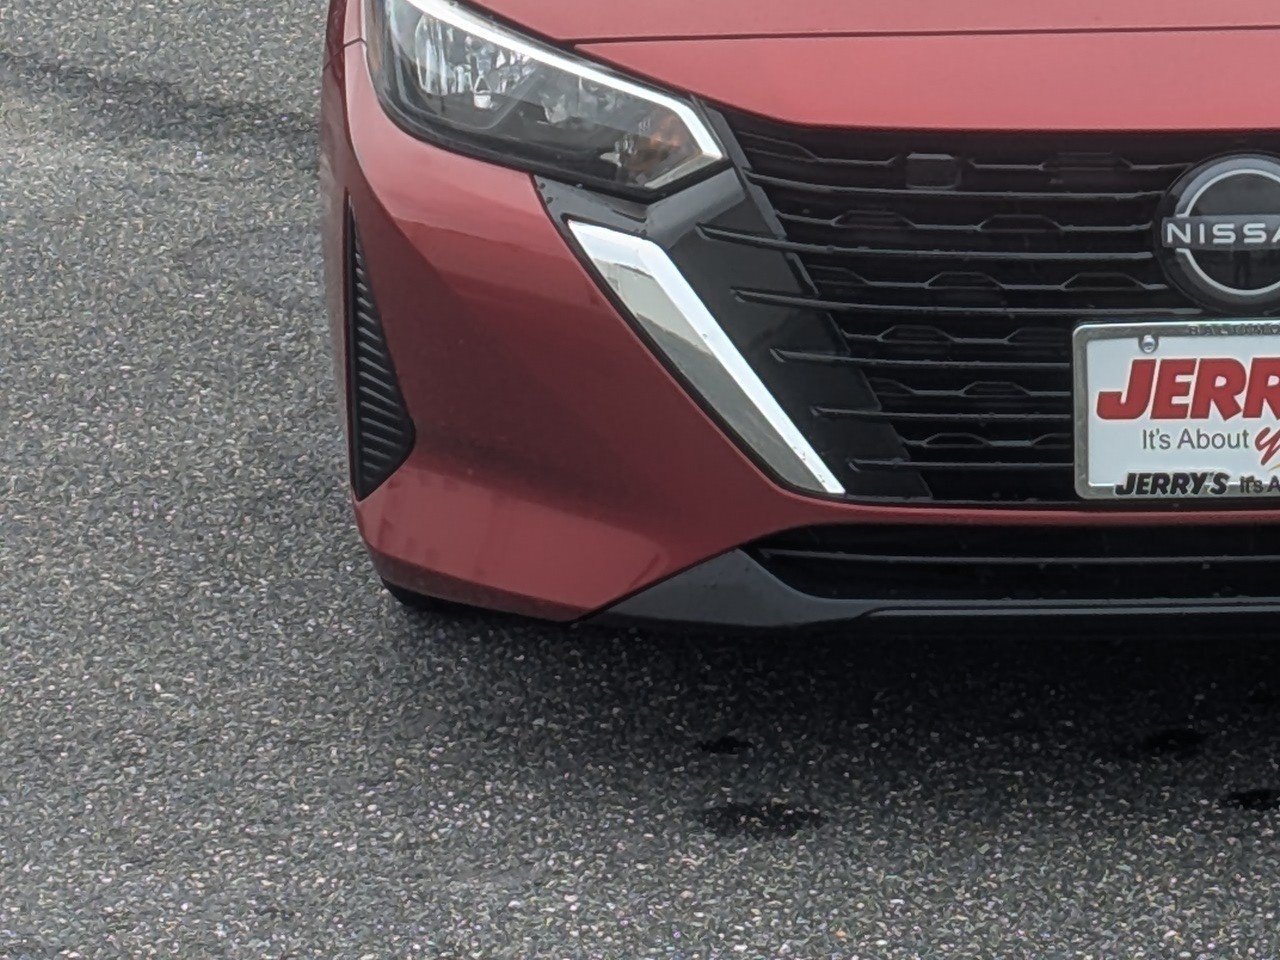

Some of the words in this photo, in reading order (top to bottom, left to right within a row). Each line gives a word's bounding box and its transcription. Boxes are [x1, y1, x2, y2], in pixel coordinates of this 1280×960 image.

[1142, 428, 1171, 450] It's
[1177, 428, 1250, 450] About
[1115, 472, 1231, 495] JERRY'S
[1239, 475, 1263, 493] It's
